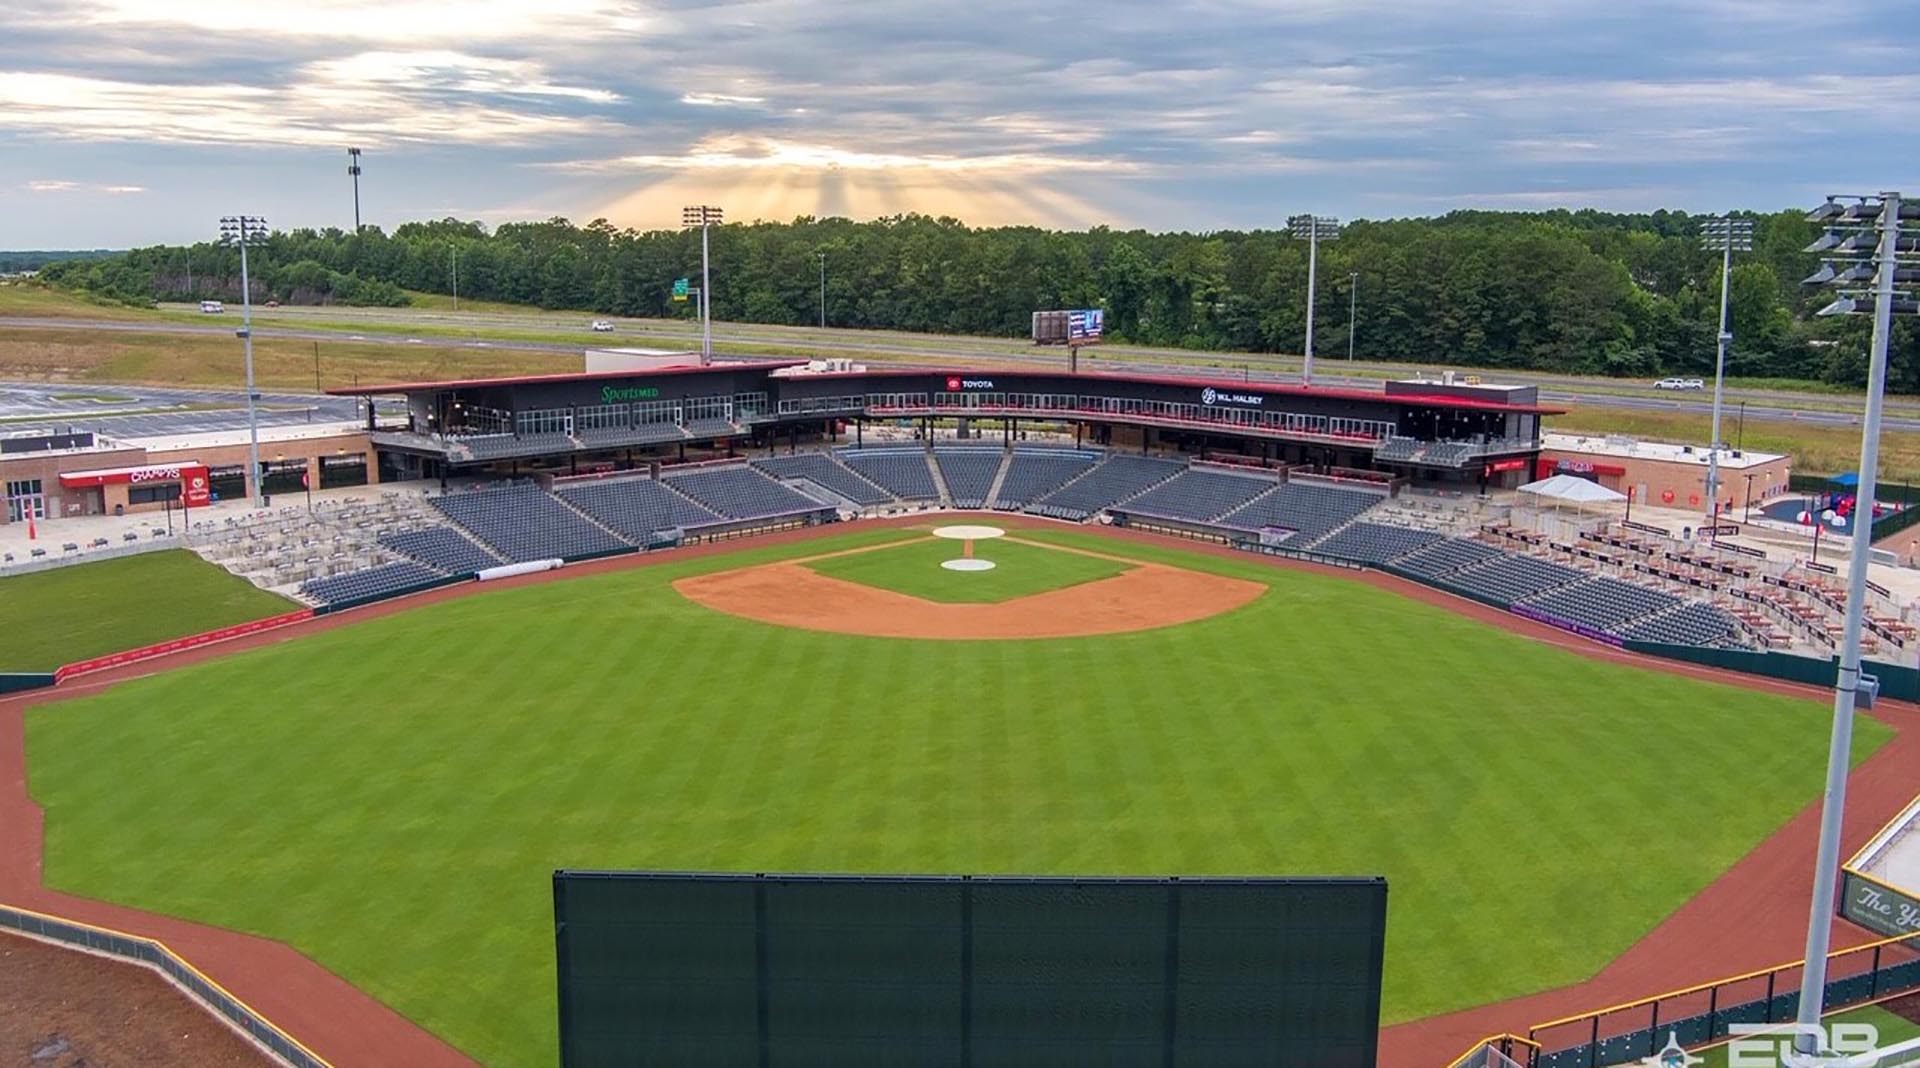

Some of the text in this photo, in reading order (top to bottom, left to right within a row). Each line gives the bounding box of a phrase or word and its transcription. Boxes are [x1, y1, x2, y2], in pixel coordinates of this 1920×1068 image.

[962, 380, 993, 388] TOYOTA
[1232, 394, 1263, 404] HALSEY
[1856, 887, 1893, 915] The
